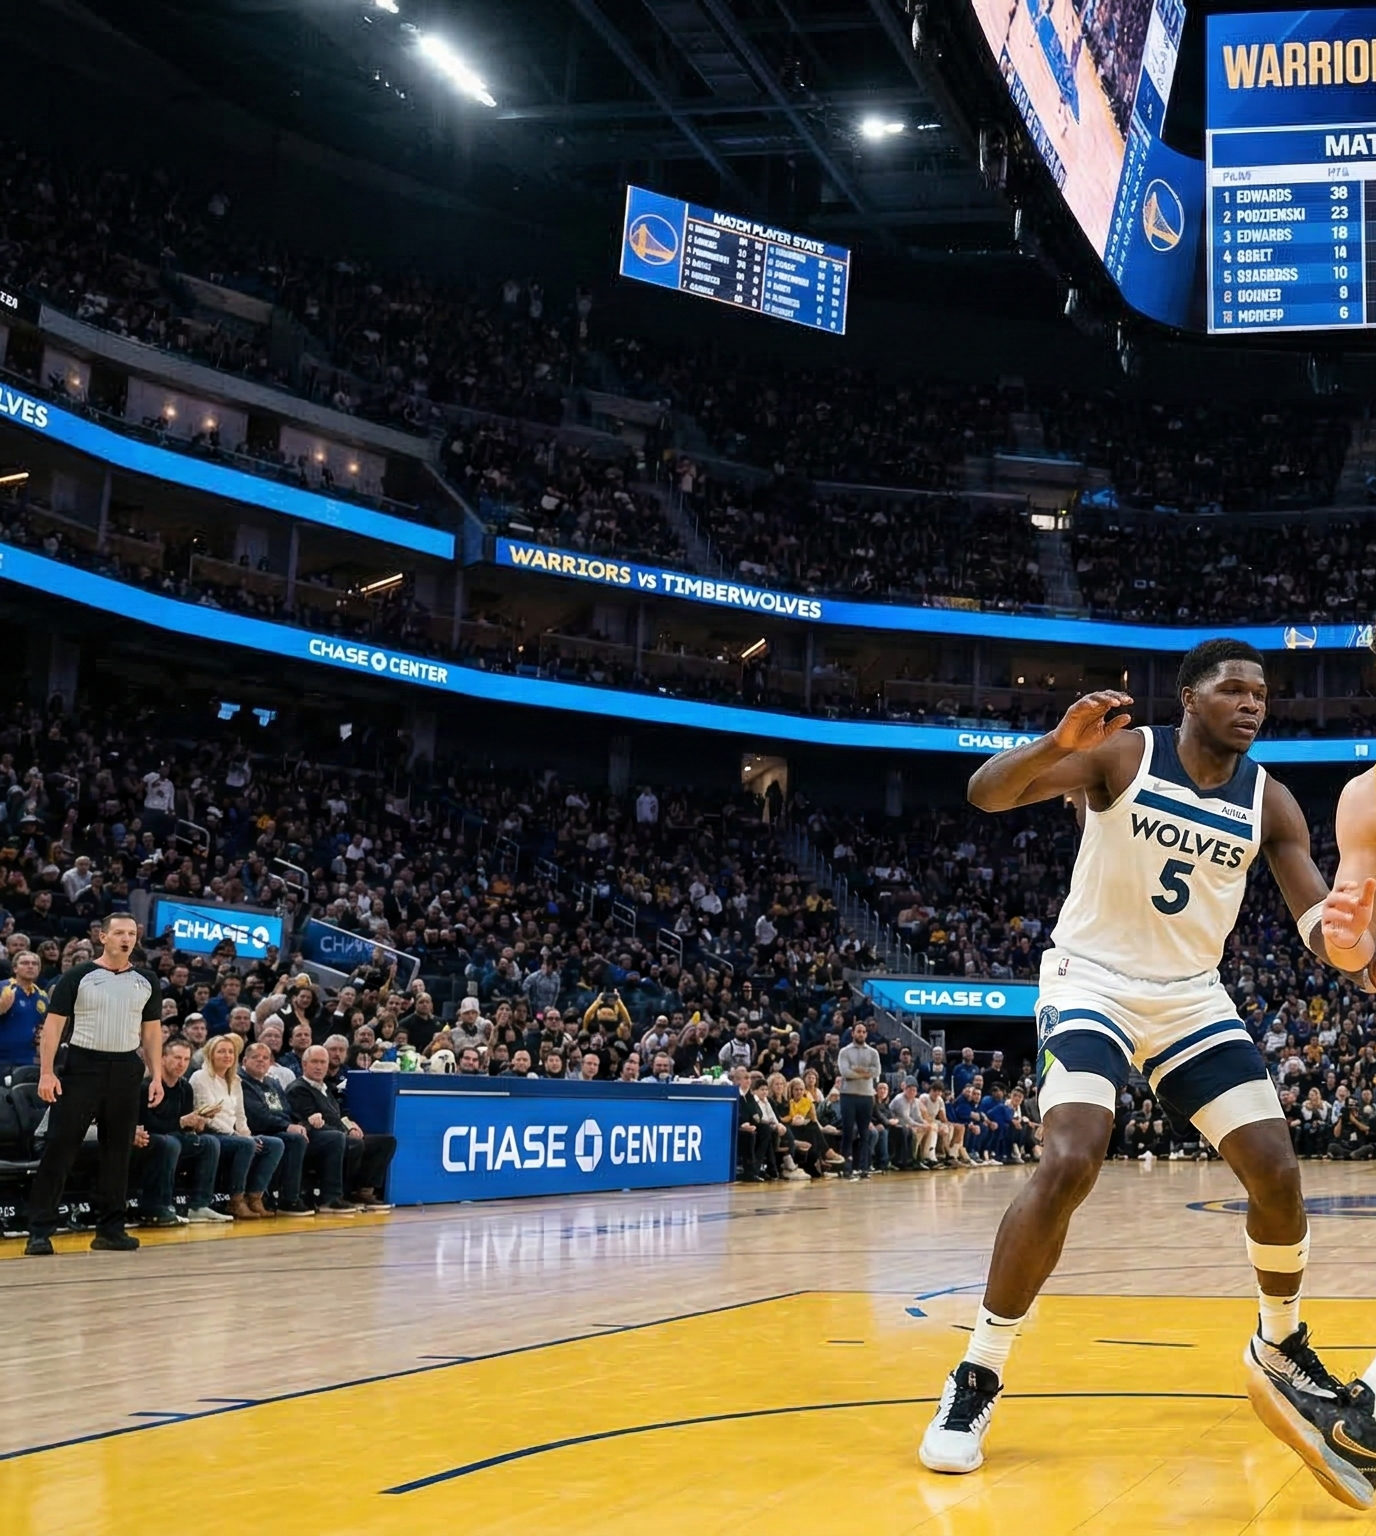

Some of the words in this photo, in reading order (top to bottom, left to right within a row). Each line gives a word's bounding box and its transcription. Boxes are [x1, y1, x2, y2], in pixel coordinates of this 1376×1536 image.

[1223, 191, 1230, 204] 1
[1236, 188, 1293, 204] EDWARDS
[1329, 186, 1349, 199] 38
[1223, 210, 1232, 224] 2
[1330, 206, 1349, 219] 23
[1223, 230, 1232, 243] 3
[1331, 226, 1349, 239] 18
[1223, 270, 1232, 283] 5
[1333, 265, 1349, 279] 10
[1339, 306, 1349, 319] 6
[509, 545, 631, 584] WARRIORS
[662, 573, 822, 619] TIMBERWOLVES
[309, 639, 369, 666] CHASE
[389, 657, 448, 684] CENTER
[958, 733, 1014, 749] CHASE
[1131, 813, 1245, 870] WOLVES
[1151, 858, 1195, 915] 5
[904, 989, 983, 1008] CHASE
[442, 1124, 568, 1173] CHASE
[609, 1124, 702, 1166] CENTER
